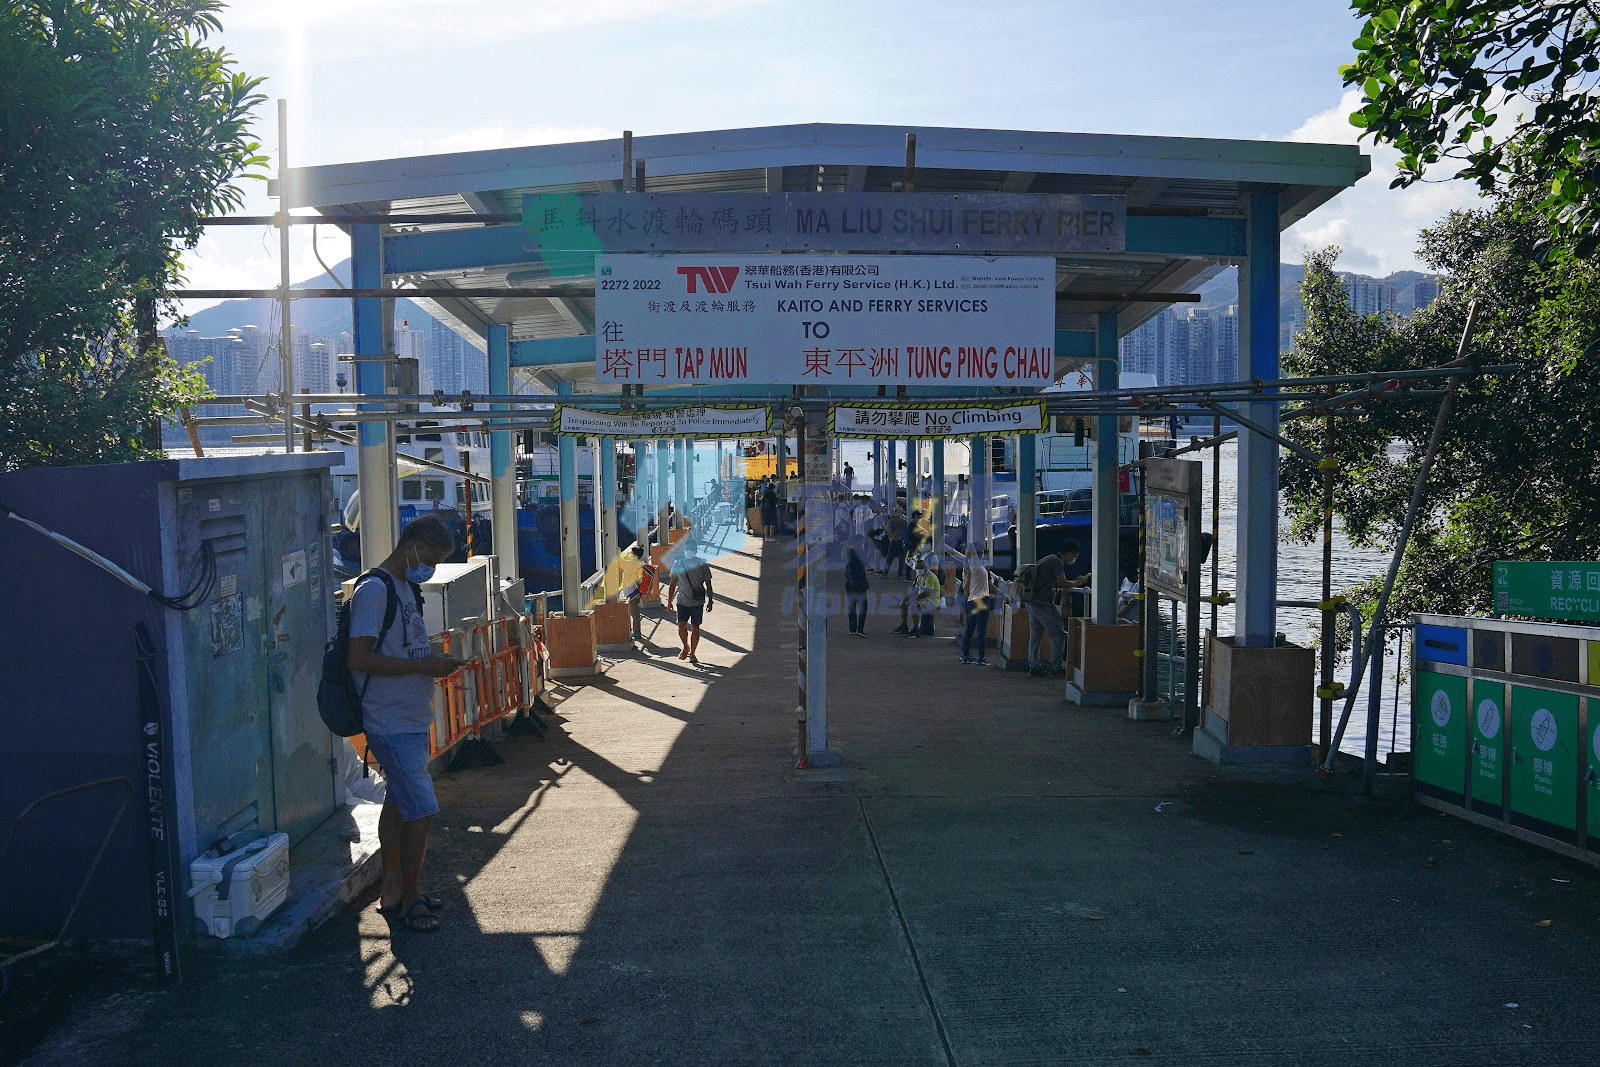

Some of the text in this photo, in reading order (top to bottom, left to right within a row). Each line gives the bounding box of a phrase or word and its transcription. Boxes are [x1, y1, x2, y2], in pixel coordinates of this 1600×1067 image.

[540, 206, 773, 236] 馬料水渡輪碼頭
[796, 208, 1115, 236] MA LIU SHUI FERRY PIER
[745, 264, 879, 277] 翠華船務(香港)有限公司
[601, 280, 661, 290] 2272 2022
[745, 278, 959, 292] Tsui Wah Ferry Service (H.K.) Ltd.
[647, 299, 756, 314] 街渡及渡輪服務
[777, 299, 988, 312] KAITO AND FERRY SERVICES
[602, 320, 625, 343] 往
[802, 321, 830, 339] TO
[602, 347, 748, 379] 塔門 TAP MUN
[802, 346, 1051, 379] 東平洲 TUNG PING CHAU
[567, 415, 760, 429] Trespassing Will Be Reported To Police Immediately
[854, 409, 1022, 426] 請勿攀爬 No Climbing
[1550, 568, 1600, 592] 資源回
